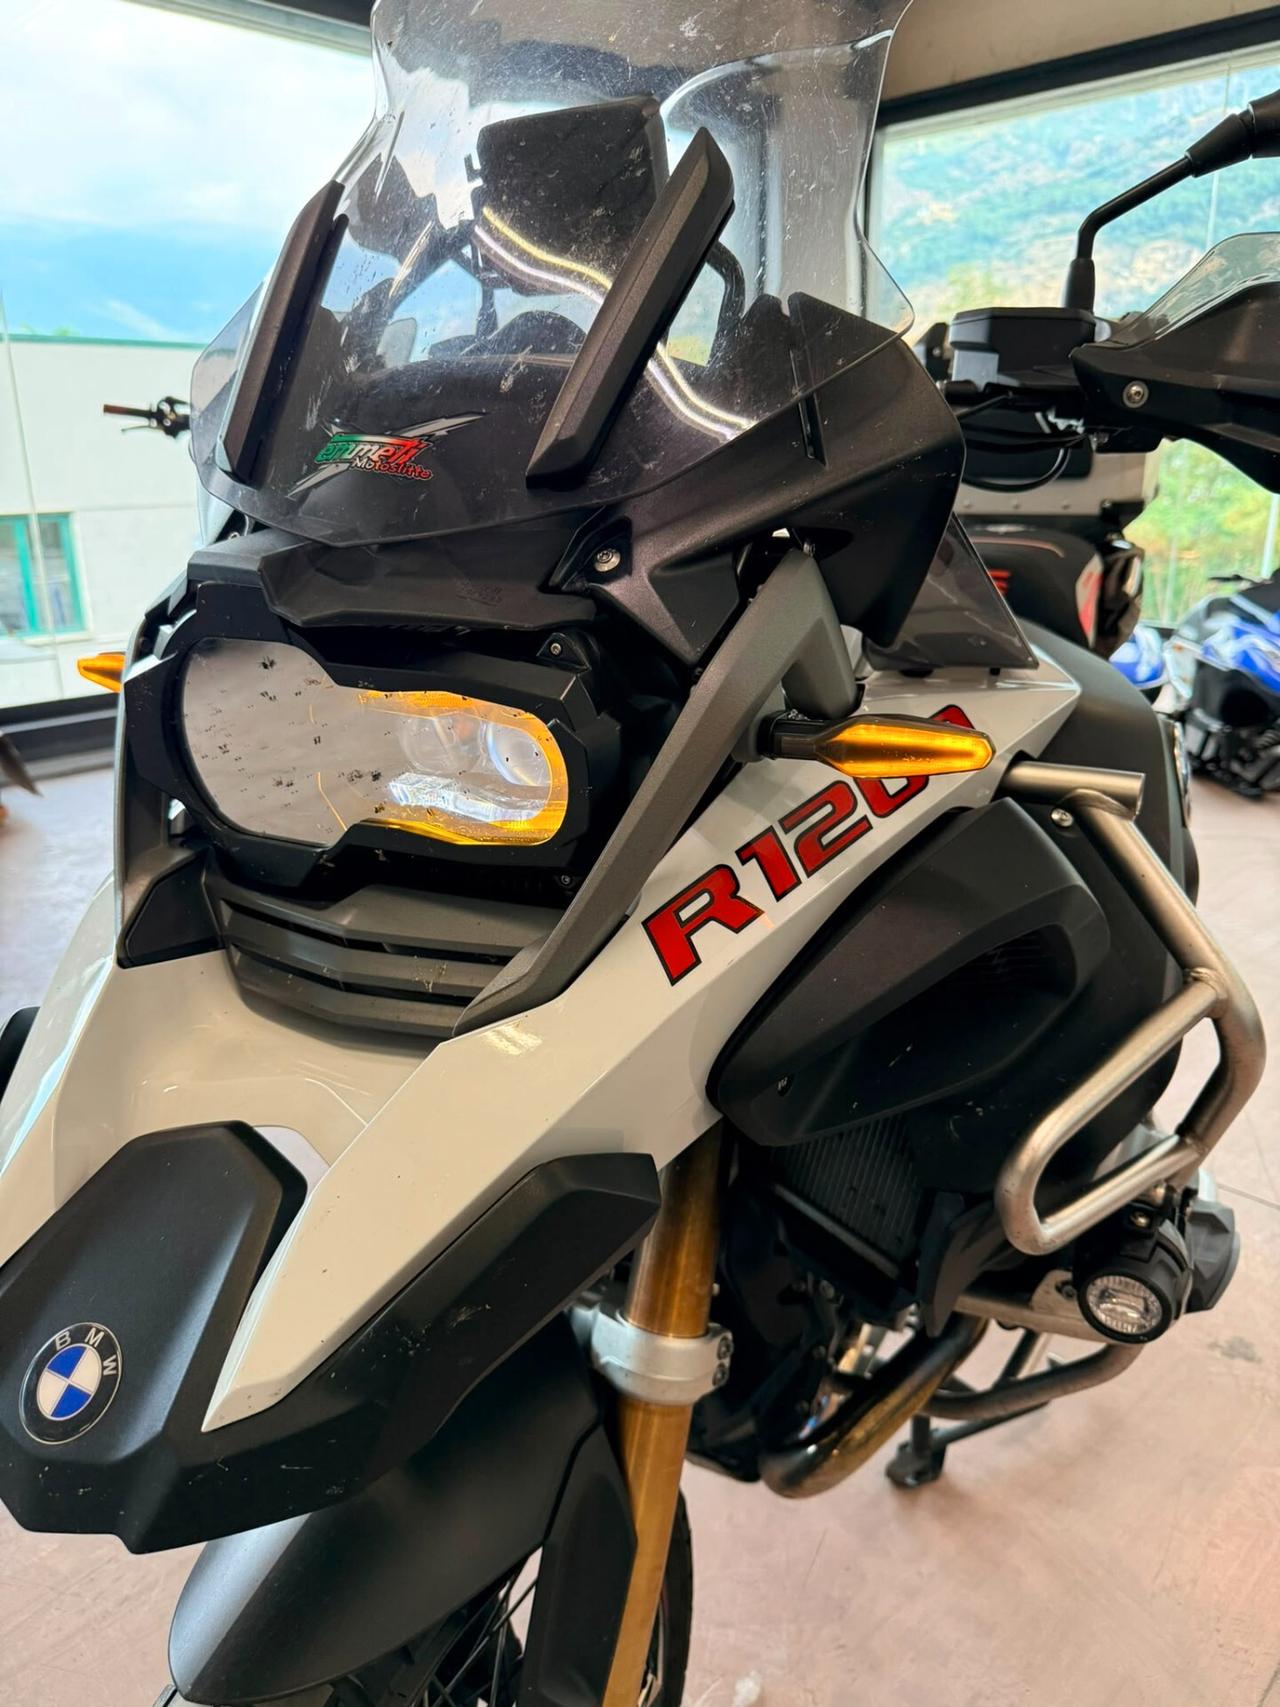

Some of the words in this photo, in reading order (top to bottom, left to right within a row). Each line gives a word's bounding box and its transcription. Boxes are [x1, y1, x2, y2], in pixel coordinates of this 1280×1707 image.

[351, 456, 433, 480] Motoslitte
[641, 704, 977, 987] R12
[54, 1326, 118, 1376] BMW
